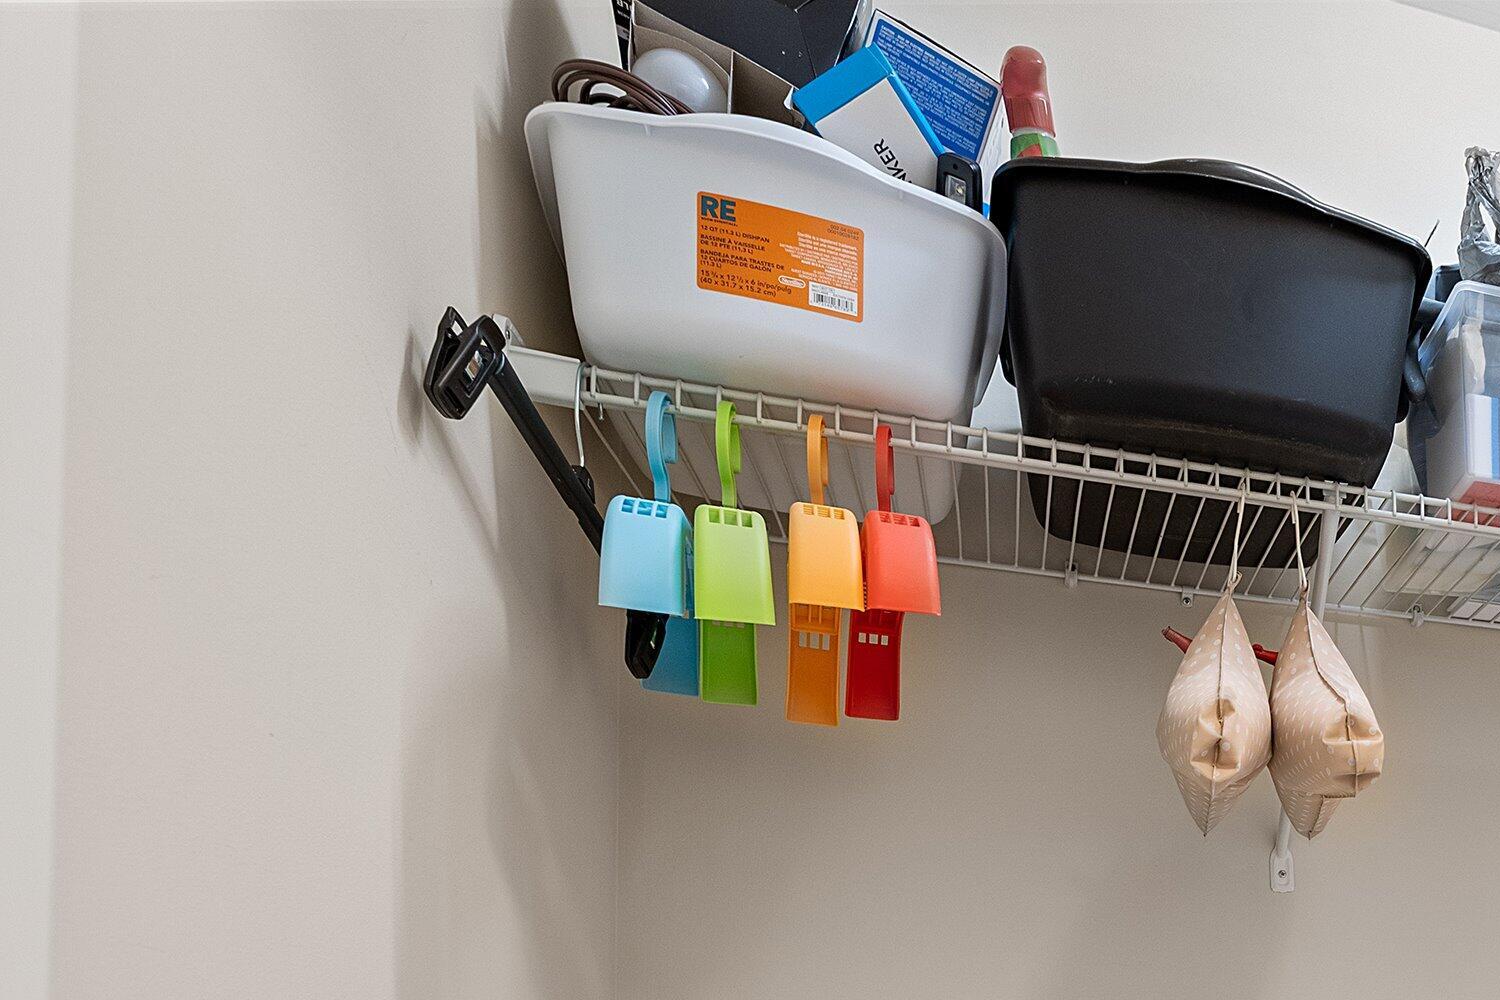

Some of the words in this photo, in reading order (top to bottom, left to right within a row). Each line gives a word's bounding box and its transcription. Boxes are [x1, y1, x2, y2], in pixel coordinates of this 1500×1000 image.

[701, 195, 736, 222] RE
[701, 234, 726, 244] BASSINE
[734, 240, 765, 251] VAISSELLE
[742, 232, 770, 243] DISHPAN
[701, 249, 729, 259] BANDEJA
[731, 254, 747, 262] PARA
[749, 257, 775, 269] TRASTES
[709, 256, 738, 266] CUARTOS
[701, 269, 709, 277] 15
[701, 276, 712, 284] (40
[720, 279, 737, 288] 31.7
[746, 284, 761, 294] 15.2
[763, 288, 776, 297] cm)
